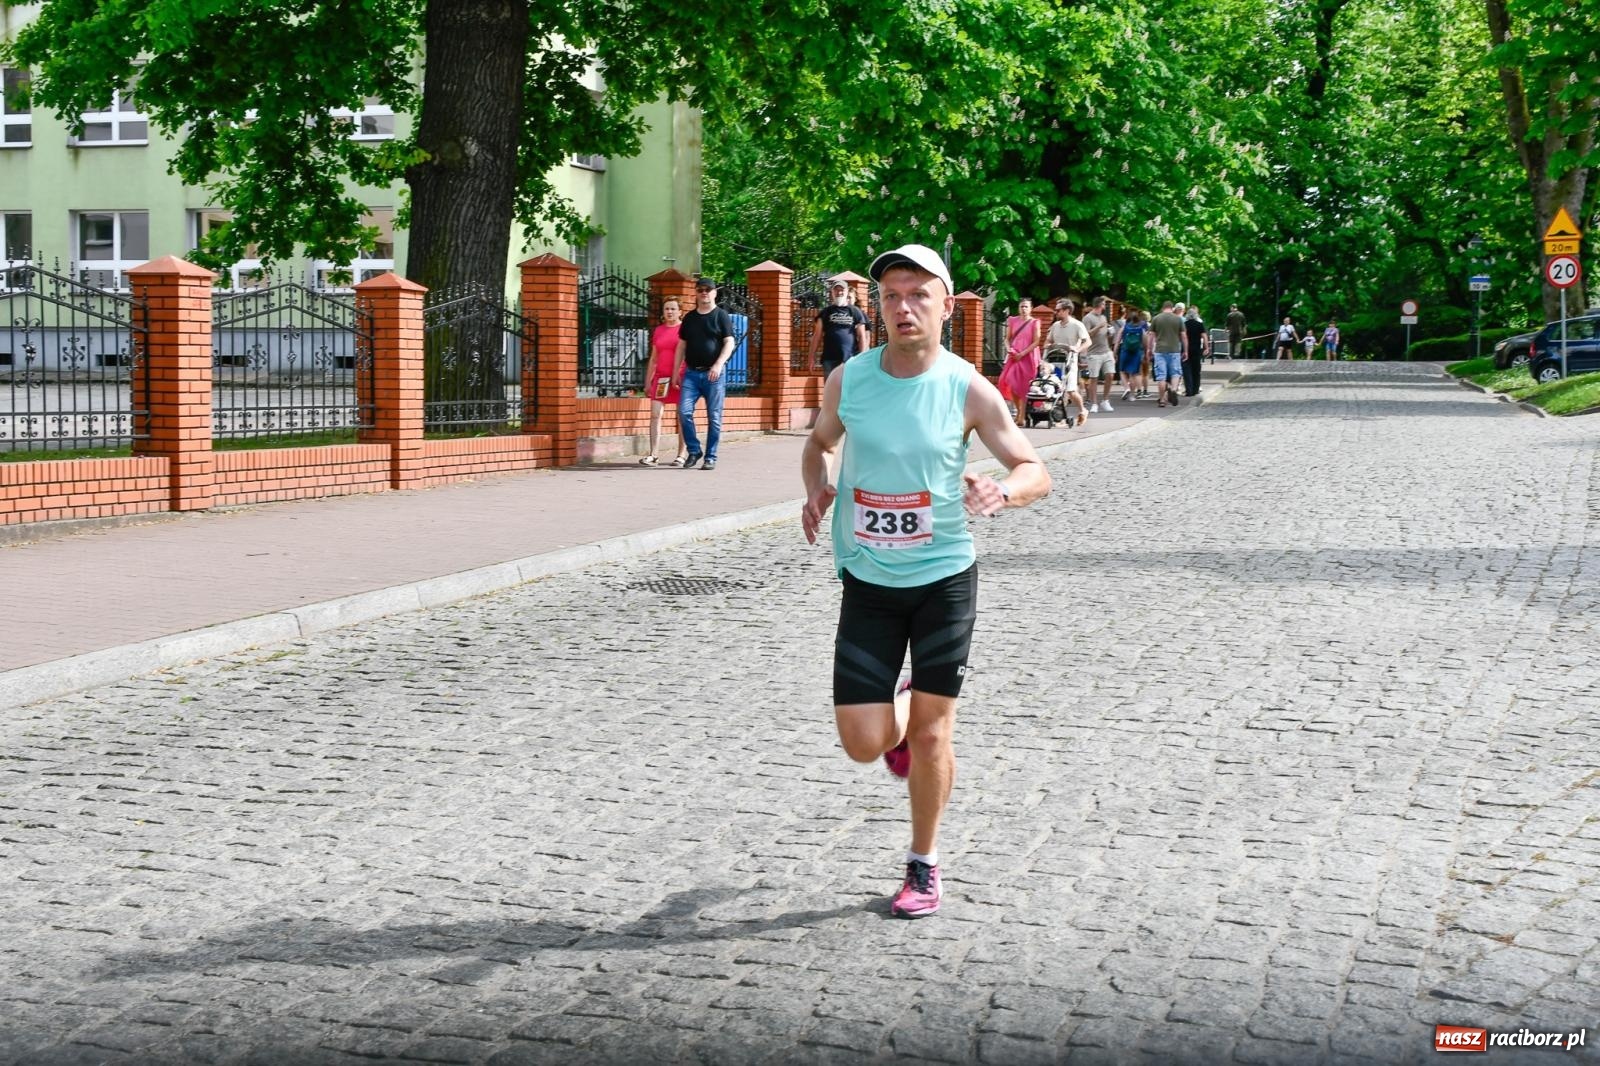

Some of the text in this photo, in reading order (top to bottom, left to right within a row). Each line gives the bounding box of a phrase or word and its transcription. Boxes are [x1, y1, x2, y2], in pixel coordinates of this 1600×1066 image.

[1552, 263, 1576, 279] 20
[895, 494, 921, 502] GRANIC
[864, 510, 919, 535] 238
